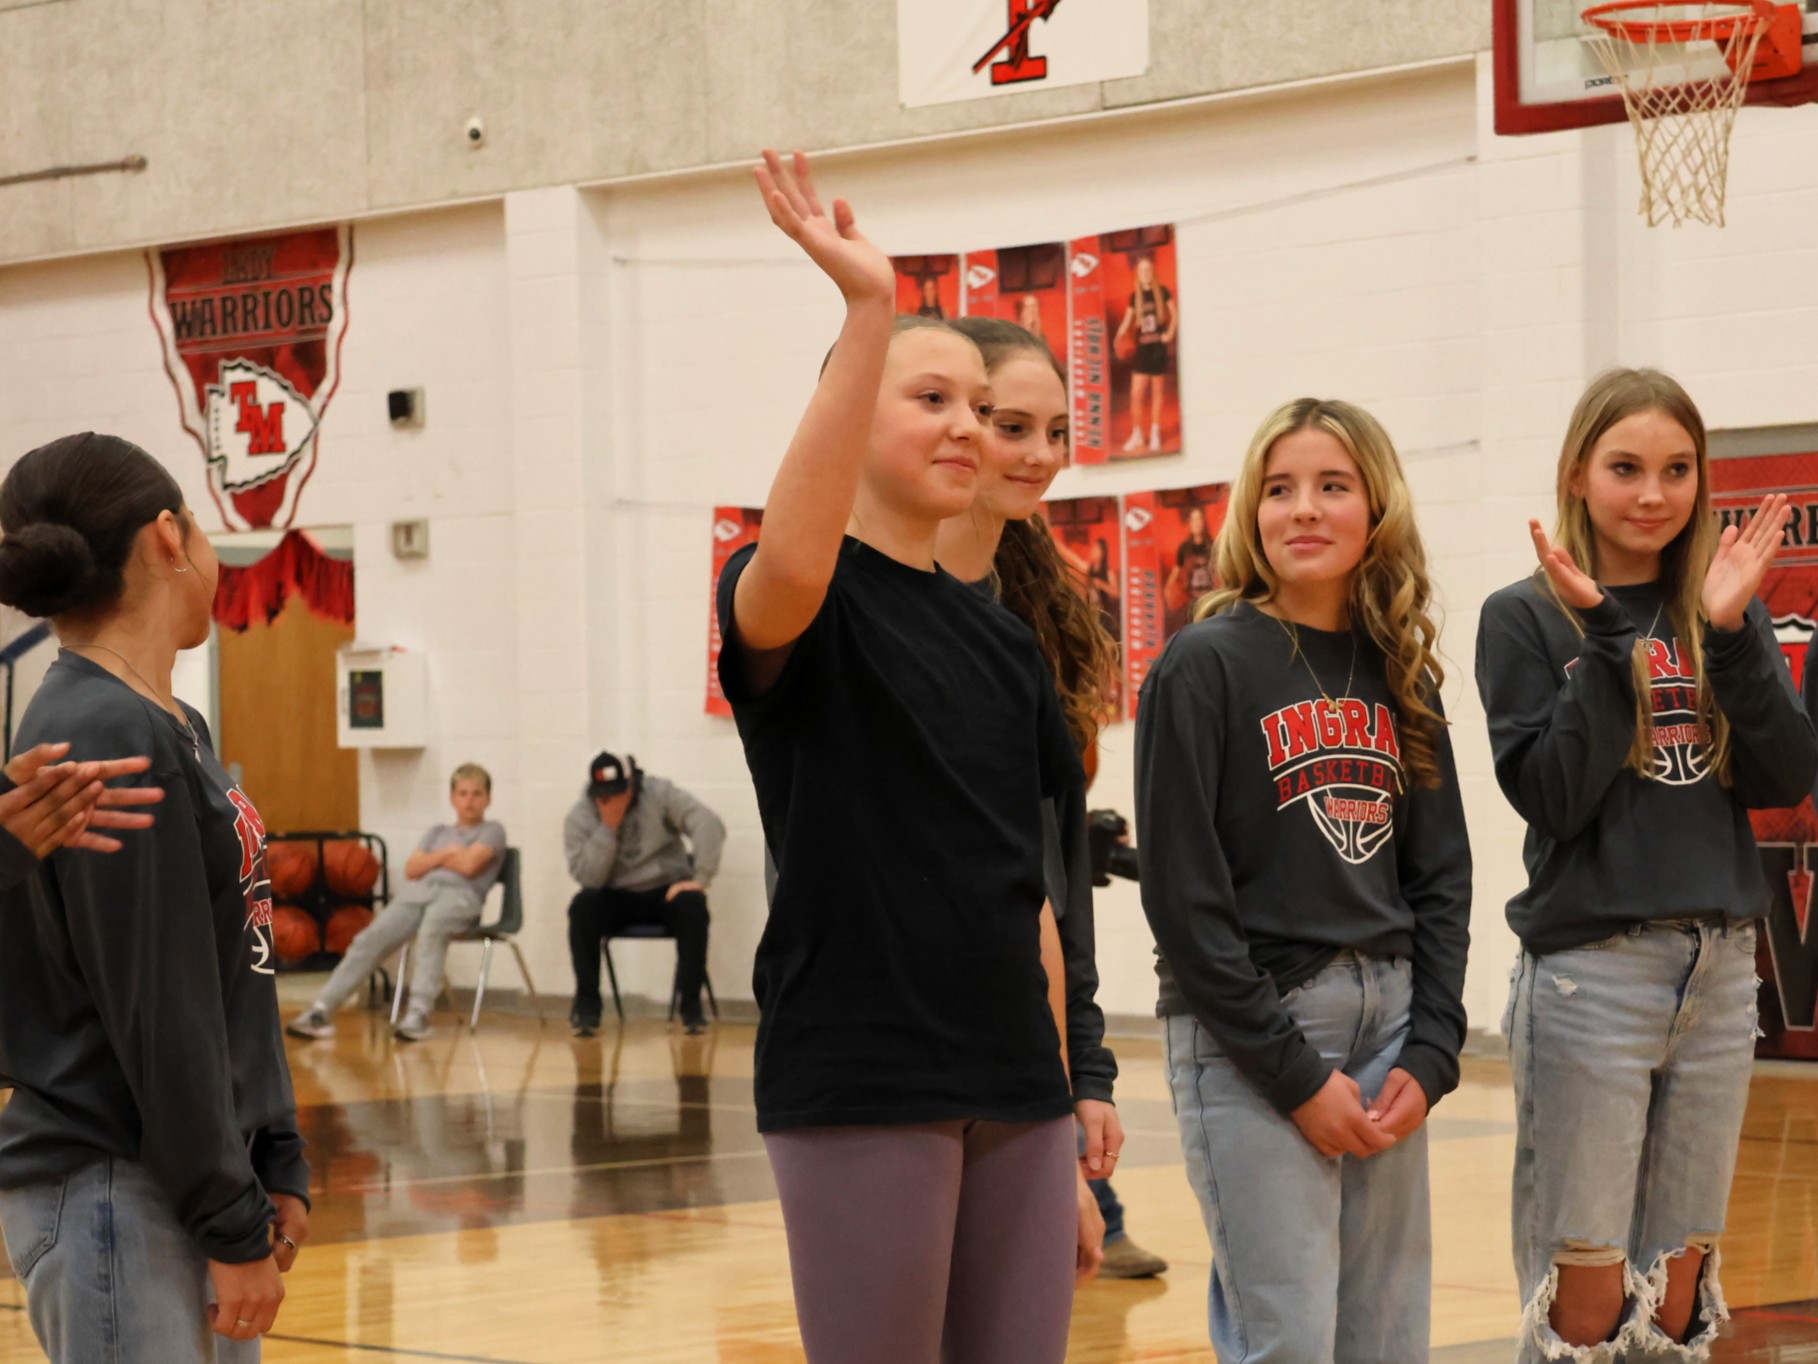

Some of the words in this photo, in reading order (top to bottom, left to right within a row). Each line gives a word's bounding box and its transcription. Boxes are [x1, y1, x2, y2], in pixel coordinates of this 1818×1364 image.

[171, 284, 333, 338] WARRIORS
[1260, 698, 1401, 771] INGRA
[1324, 796, 1389, 824] WARRIORS
